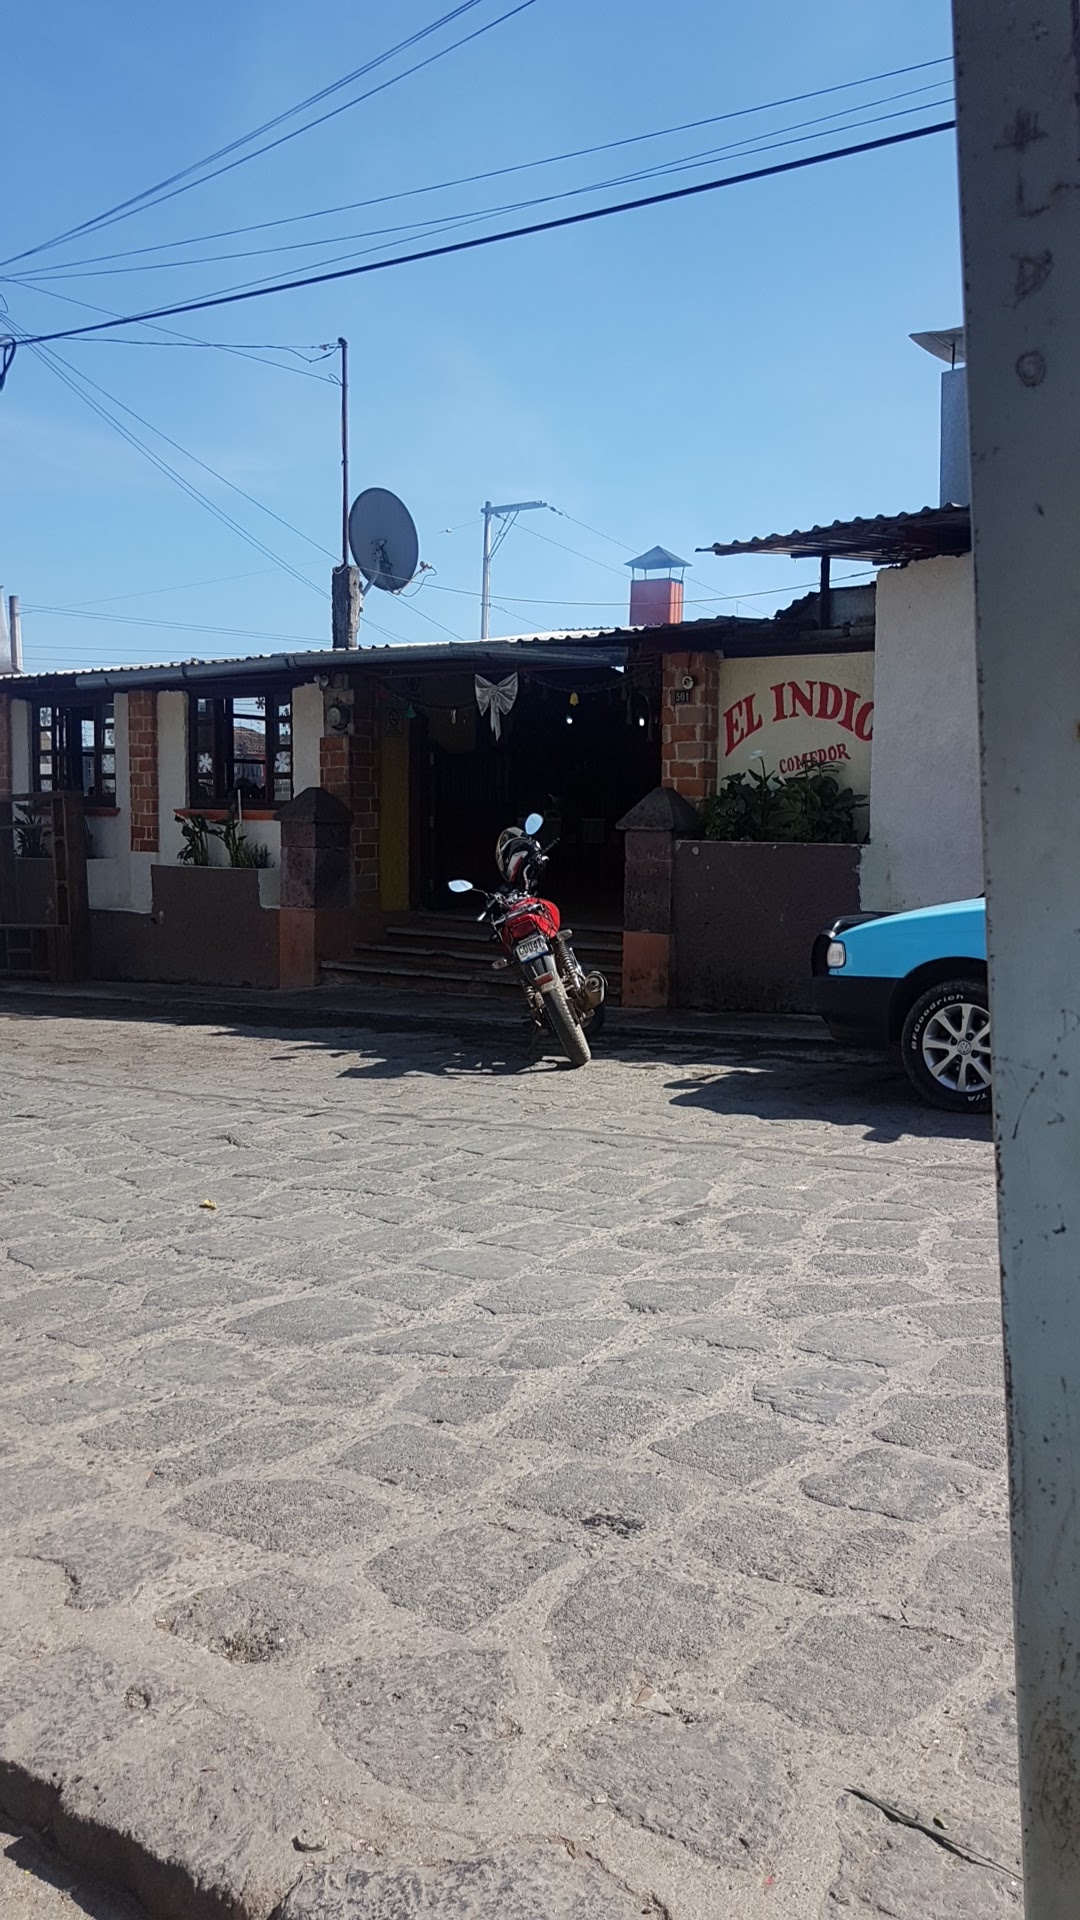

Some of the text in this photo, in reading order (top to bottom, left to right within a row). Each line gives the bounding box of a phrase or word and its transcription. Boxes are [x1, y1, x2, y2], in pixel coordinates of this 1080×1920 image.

[675, 692, 690, 702] 501
[722, 693, 763, 757] EL
[779, 743, 851, 774] COMEDOR
[911, 993, 964, 1050] BFGoodrich
